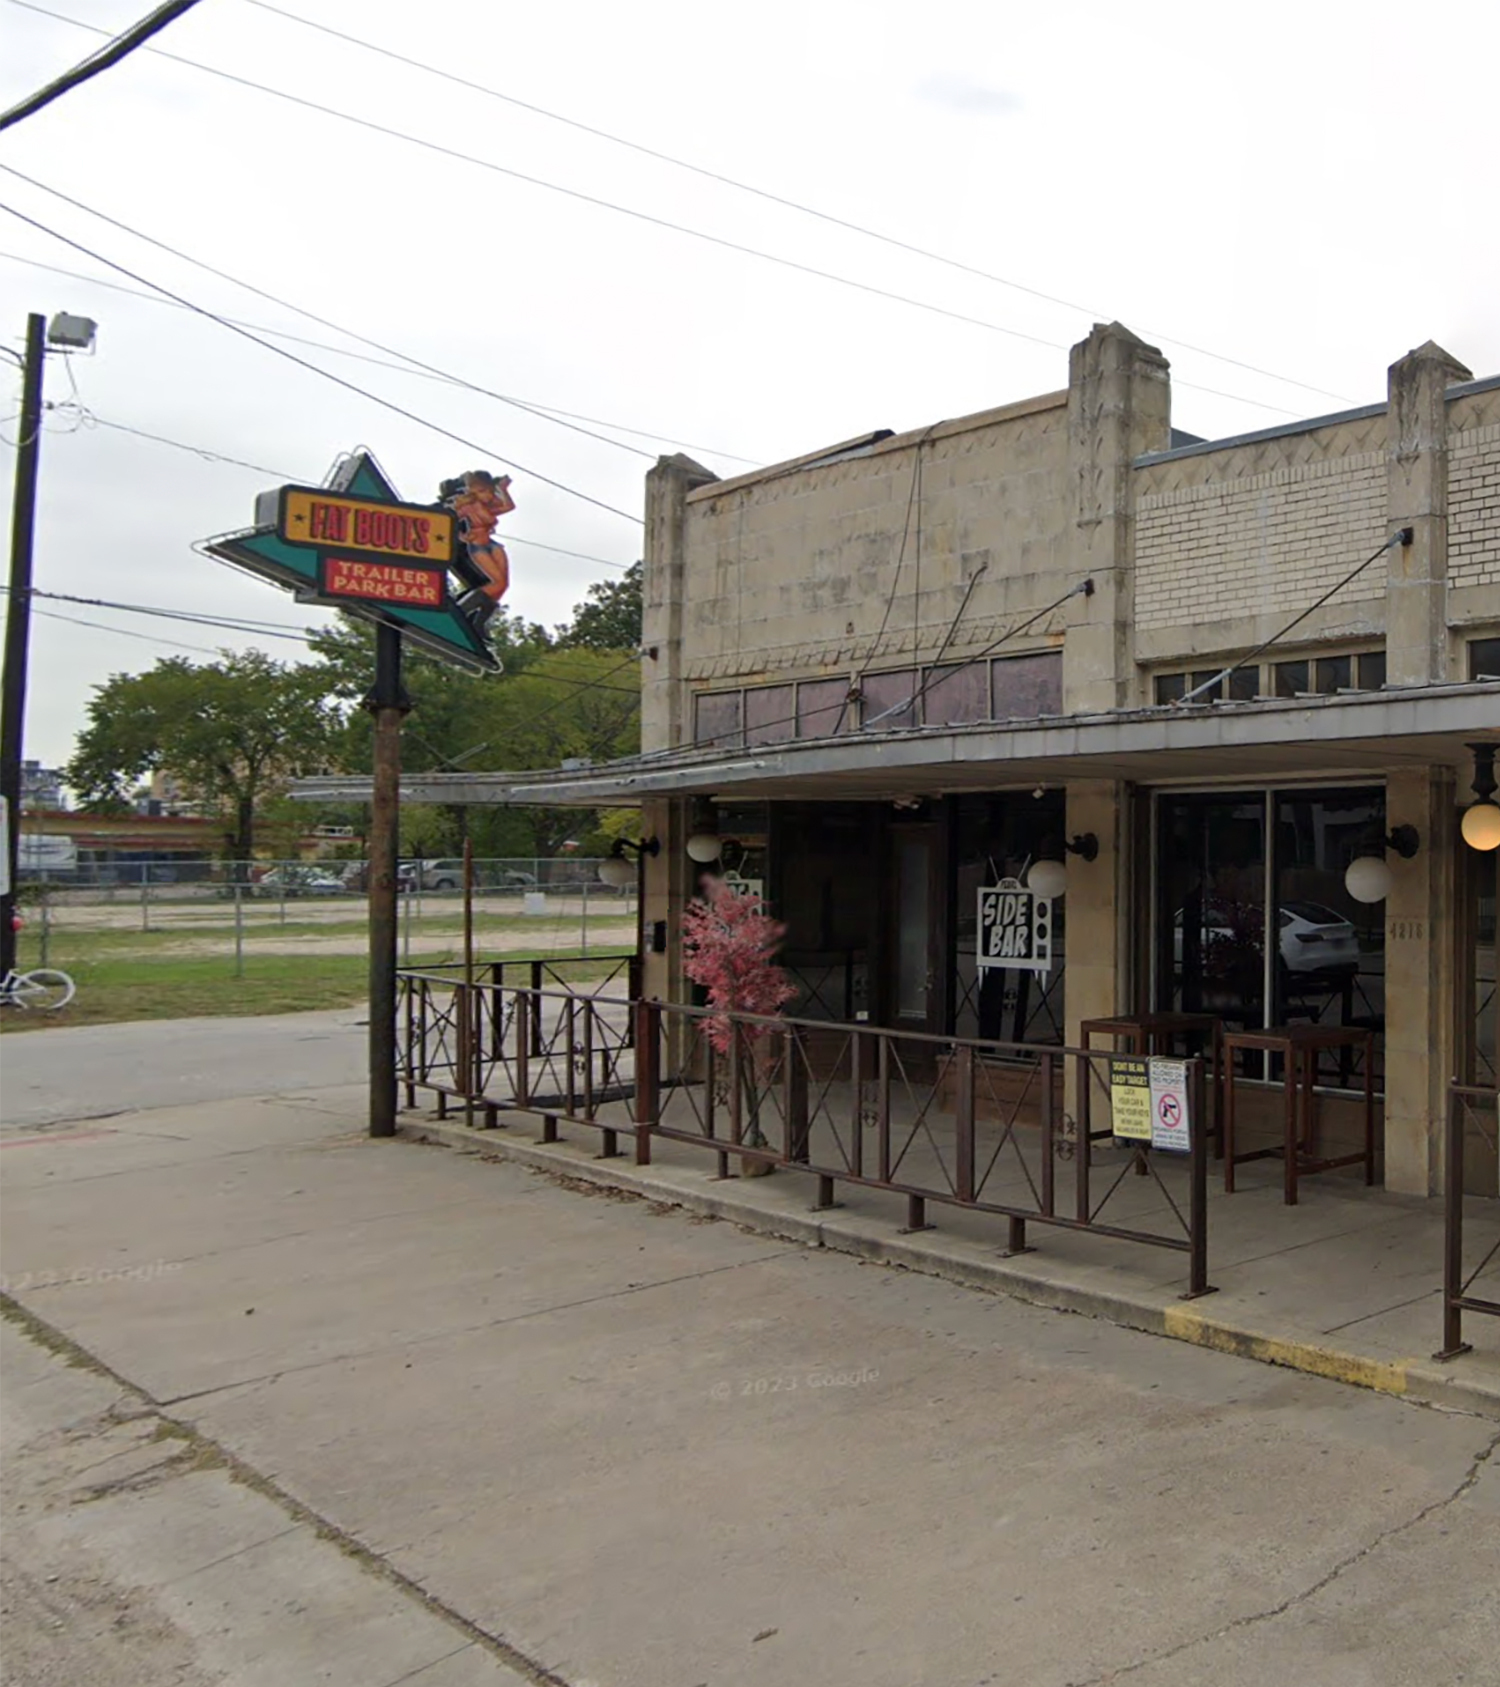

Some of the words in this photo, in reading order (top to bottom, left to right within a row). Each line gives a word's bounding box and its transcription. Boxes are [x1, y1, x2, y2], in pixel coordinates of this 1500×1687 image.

[310, 502, 351, 542] FAT
[354, 508, 430, 553] BOOTS
[334, 576, 391, 597] PARK
[394, 583, 437, 600] BAR
[339, 561, 429, 585] TRAILER
[983, 894, 1028, 926] SIDE
[989, 925, 1028, 957] BAR
